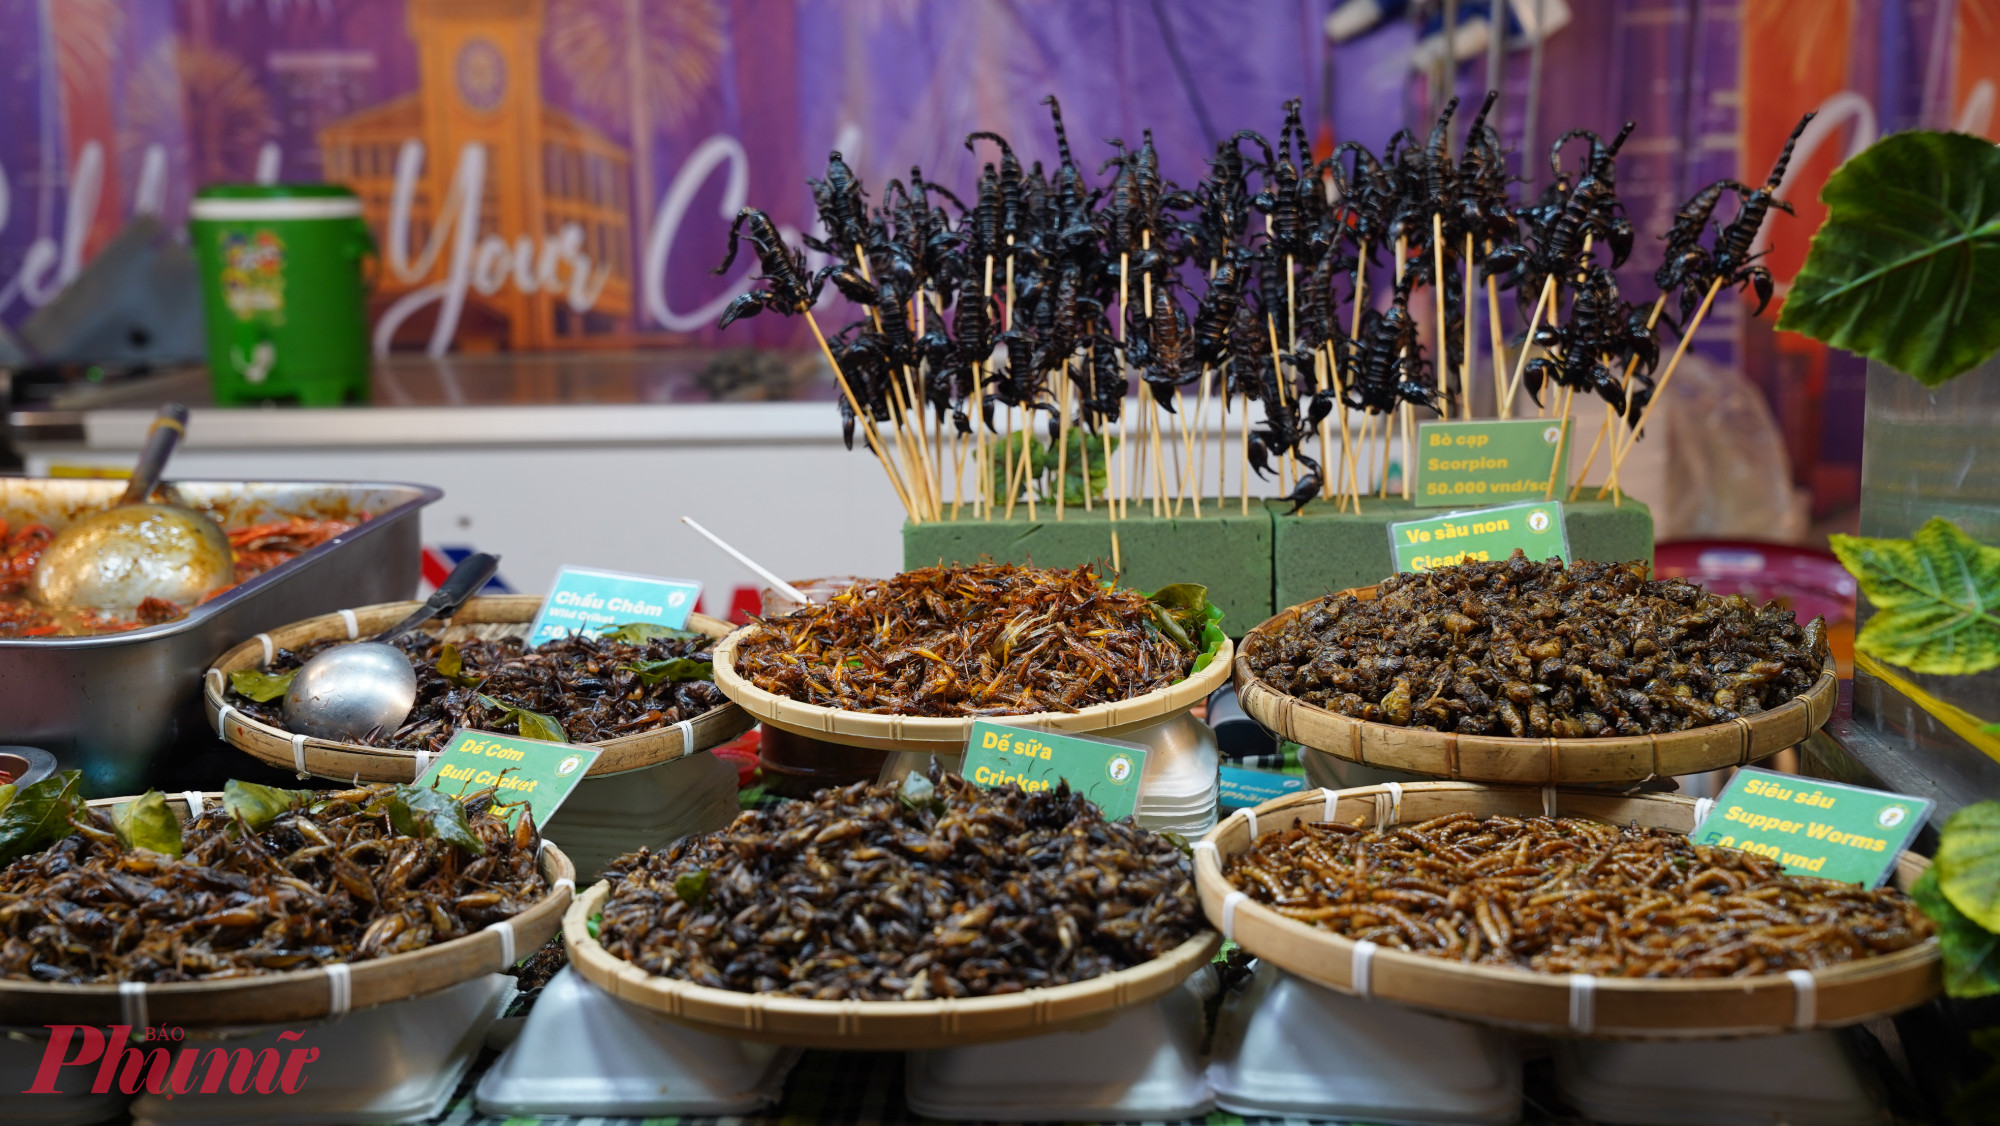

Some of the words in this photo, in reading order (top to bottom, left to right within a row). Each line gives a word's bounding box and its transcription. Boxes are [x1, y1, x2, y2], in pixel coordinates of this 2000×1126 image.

[374, 139, 610, 360] Your
[1429, 433, 1452, 447] Bò
[1456, 434, 1489, 448] cạp
[1427, 457, 1508, 472] Scorpion
[1427, 481, 1487, 496] 50.000
[1406, 529, 1431, 544] Ve
[1434, 523, 1469, 541] sầu
[1472, 519, 1510, 535] non
[549, 608, 576, 620] Wild
[577, 610, 615, 624] Criket
[555, 591, 605, 610] Chấu
[607, 598, 663, 617] Chôm
[459, 739, 491, 755] Dế
[485, 744, 525, 762] Cơm
[982, 731, 1014, 752] Dế
[1013, 738, 1053, 760] sữa
[438, 764, 477, 782] Bull
[474, 770, 538, 793] Cricket
[1744, 779, 1794, 801] Siêu
[1793, 791, 1836, 809] sâu
[1724, 806, 1804, 834] Supper
[1806, 821, 1887, 852] Worms
[1781, 851, 1827, 872] vnd
